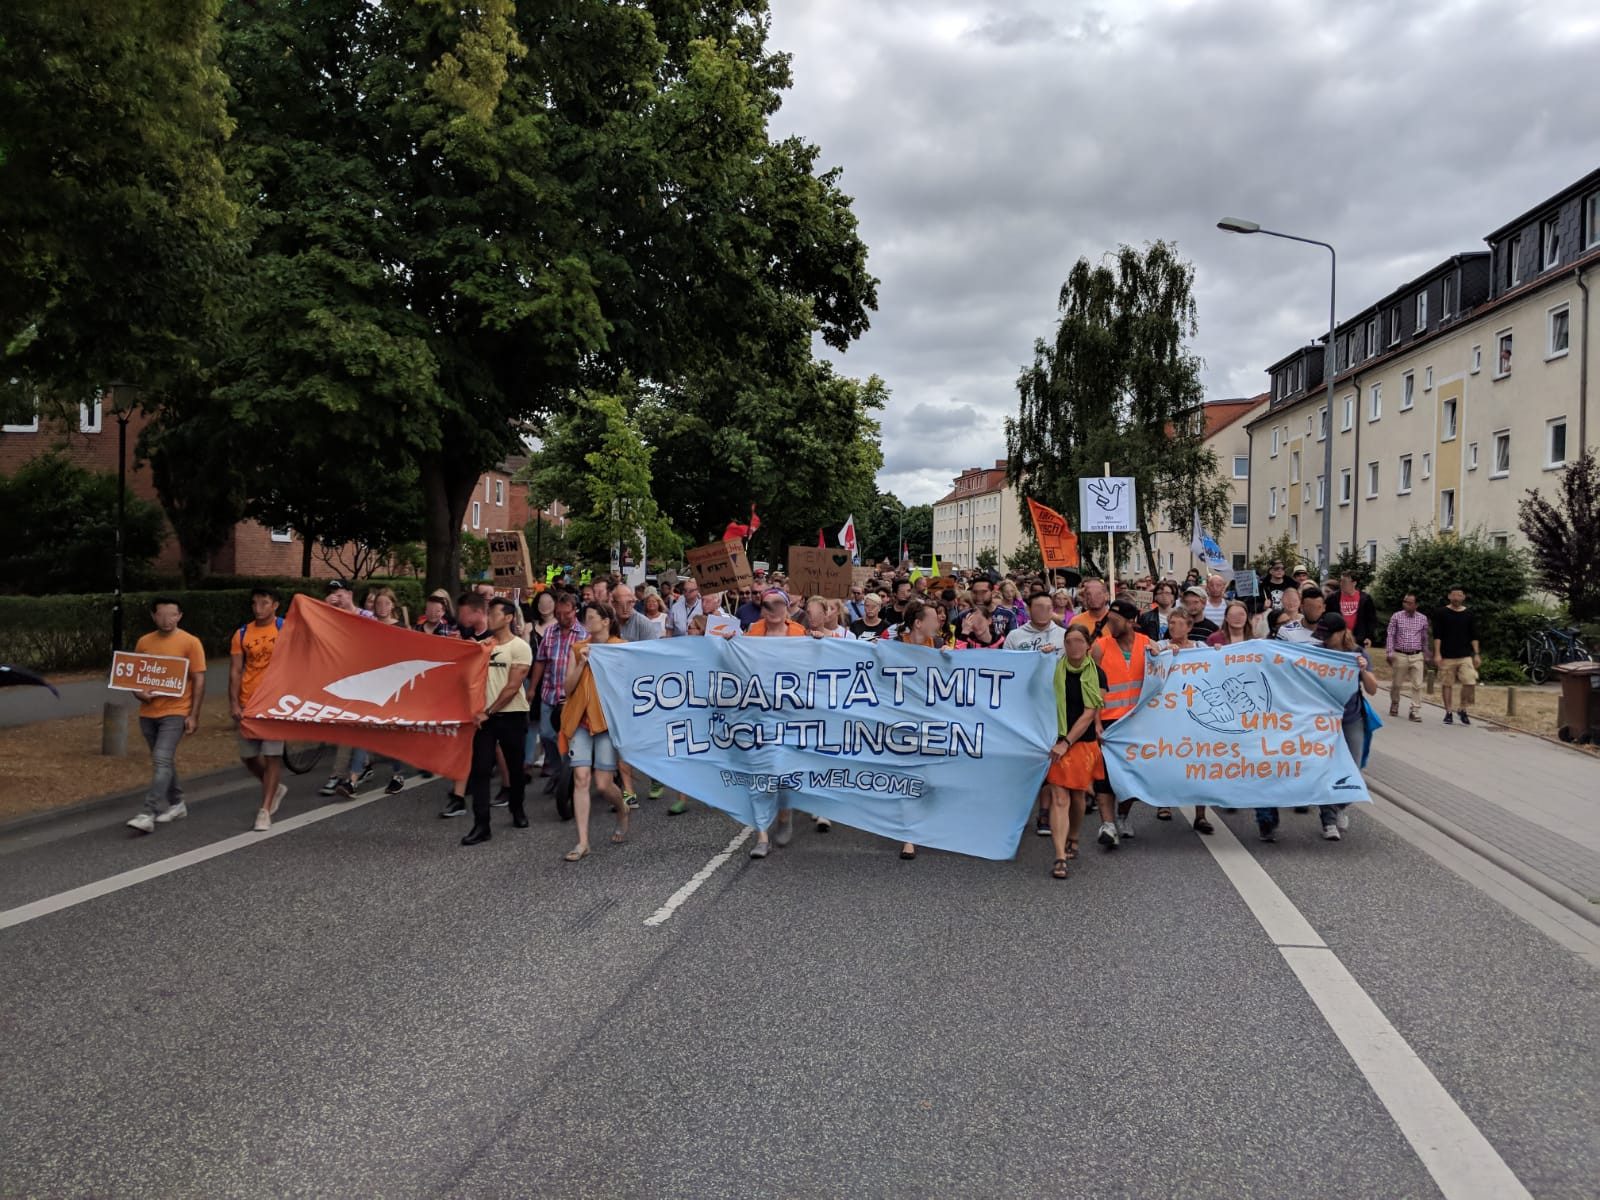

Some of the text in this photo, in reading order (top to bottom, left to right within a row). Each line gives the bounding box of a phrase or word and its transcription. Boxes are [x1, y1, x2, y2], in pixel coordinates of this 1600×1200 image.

[490, 541, 518, 552] KEIN
[494, 567, 516, 576] MIT
[116, 662, 134, 677] 69
[139, 660, 167, 674] Jedes
[1225, 652, 1263, 666] Hass
[1273, 655, 1285, 666] &
[1294, 655, 1355, 682] Angst!
[136, 673, 160, 687] Leben
[632, 660, 1015, 716] SOLIDARITÄT MIT
[1241, 711, 1293, 732] uns
[666, 713, 983, 759] FLÜCHTLINGEN
[1125, 736, 1241, 762] schönes
[1185, 755, 1301, 780] machen!
[808, 768, 925, 798] WELCOME
